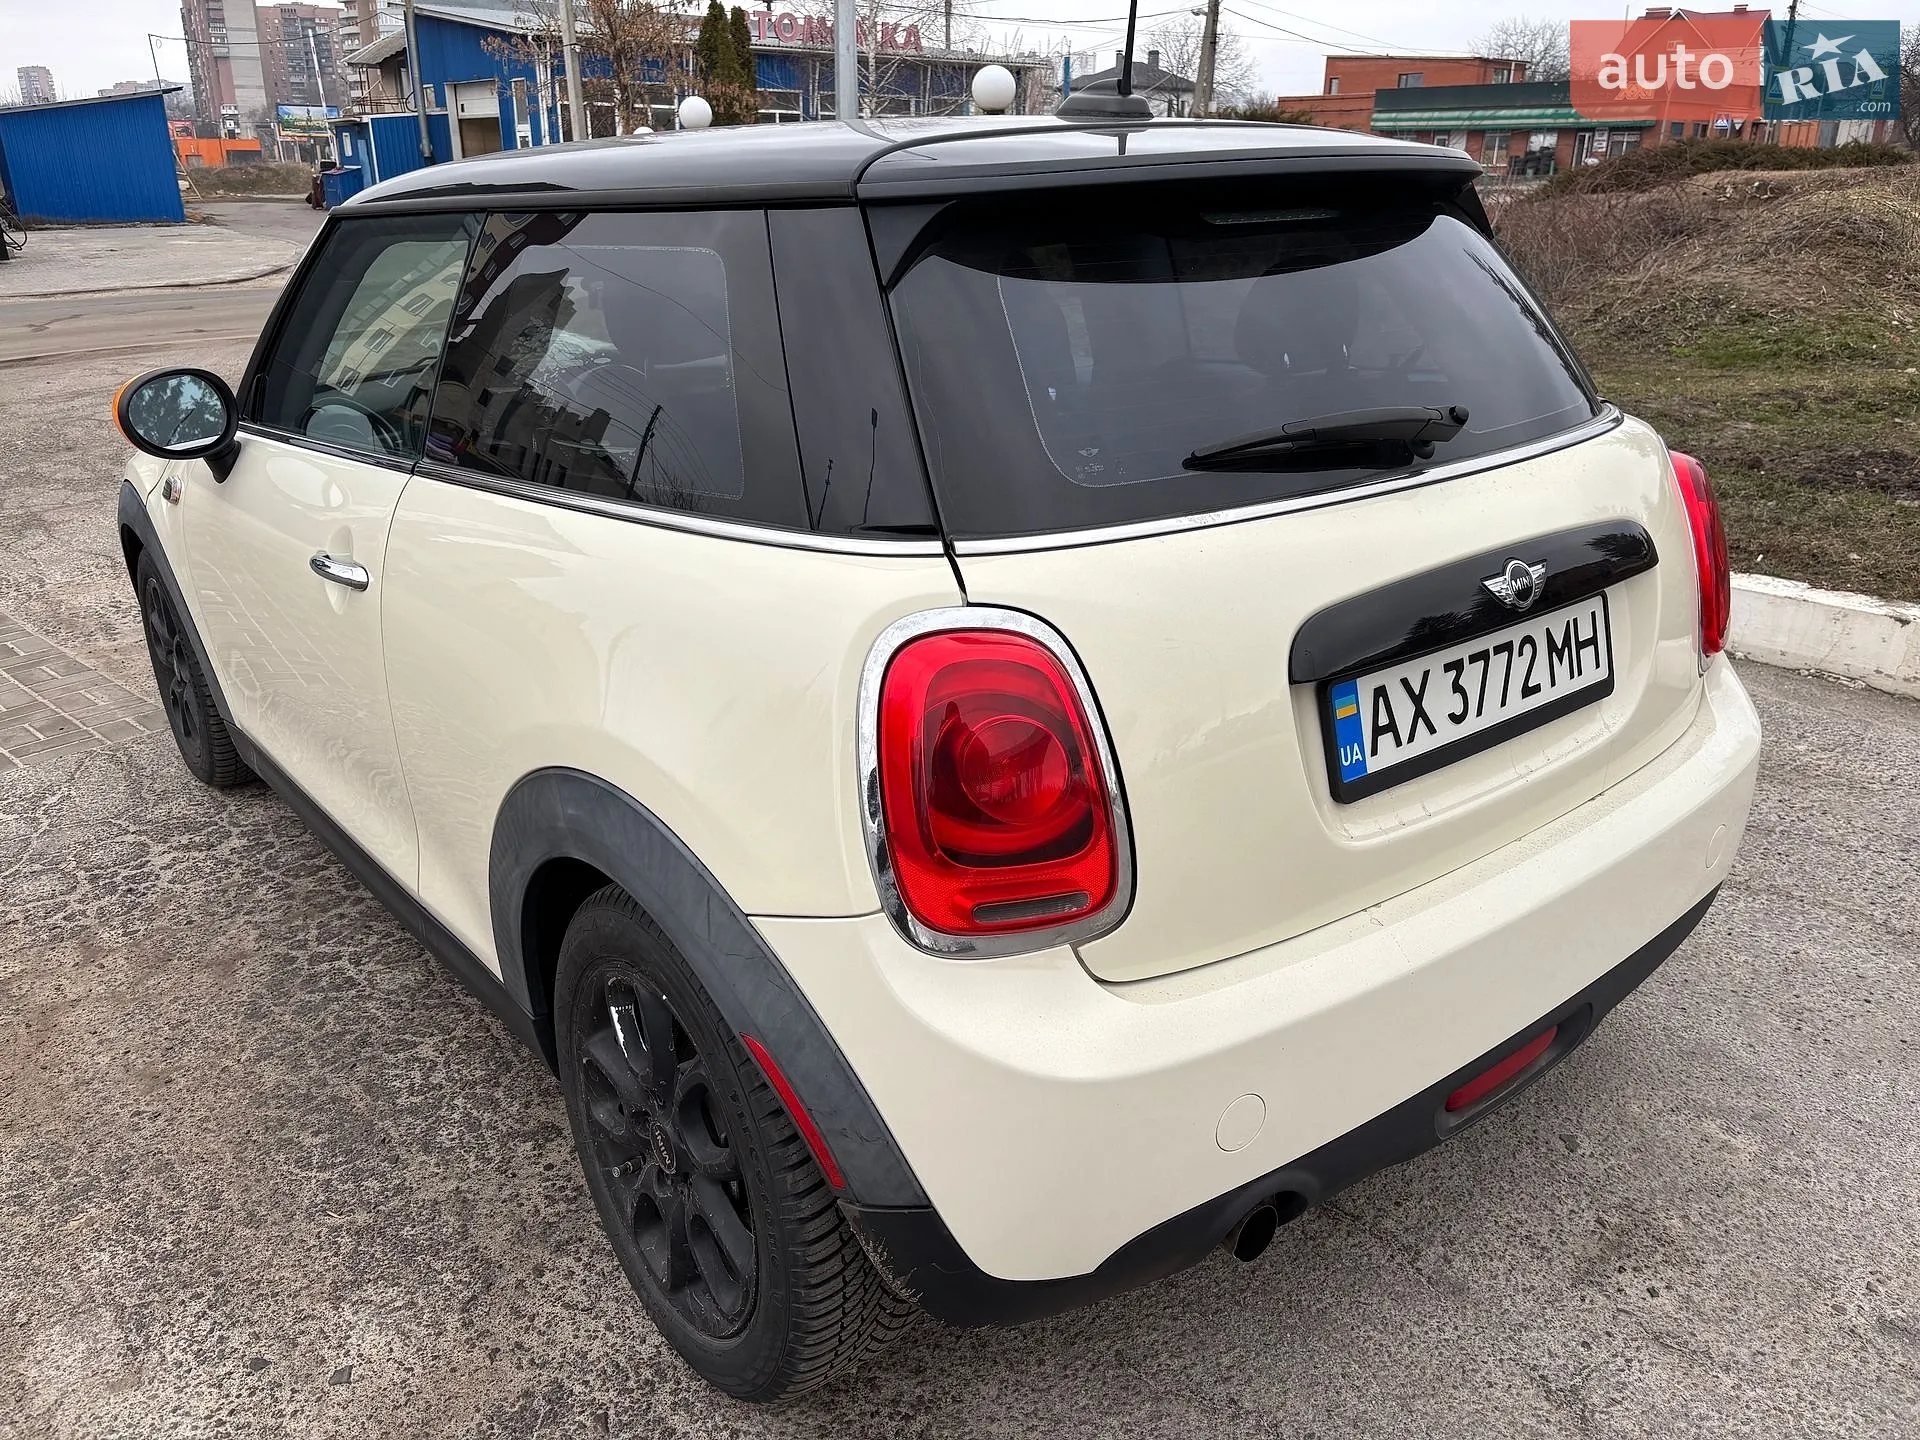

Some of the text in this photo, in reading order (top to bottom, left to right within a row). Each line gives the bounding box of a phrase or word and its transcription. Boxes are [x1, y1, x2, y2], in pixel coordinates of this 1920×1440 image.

[1511, 575, 1533, 592] MINI
[1370, 610, 1600, 757] AX 3772 MH
[1340, 743, 1363, 767] UA
[655, 1130, 671, 1165] MINI
